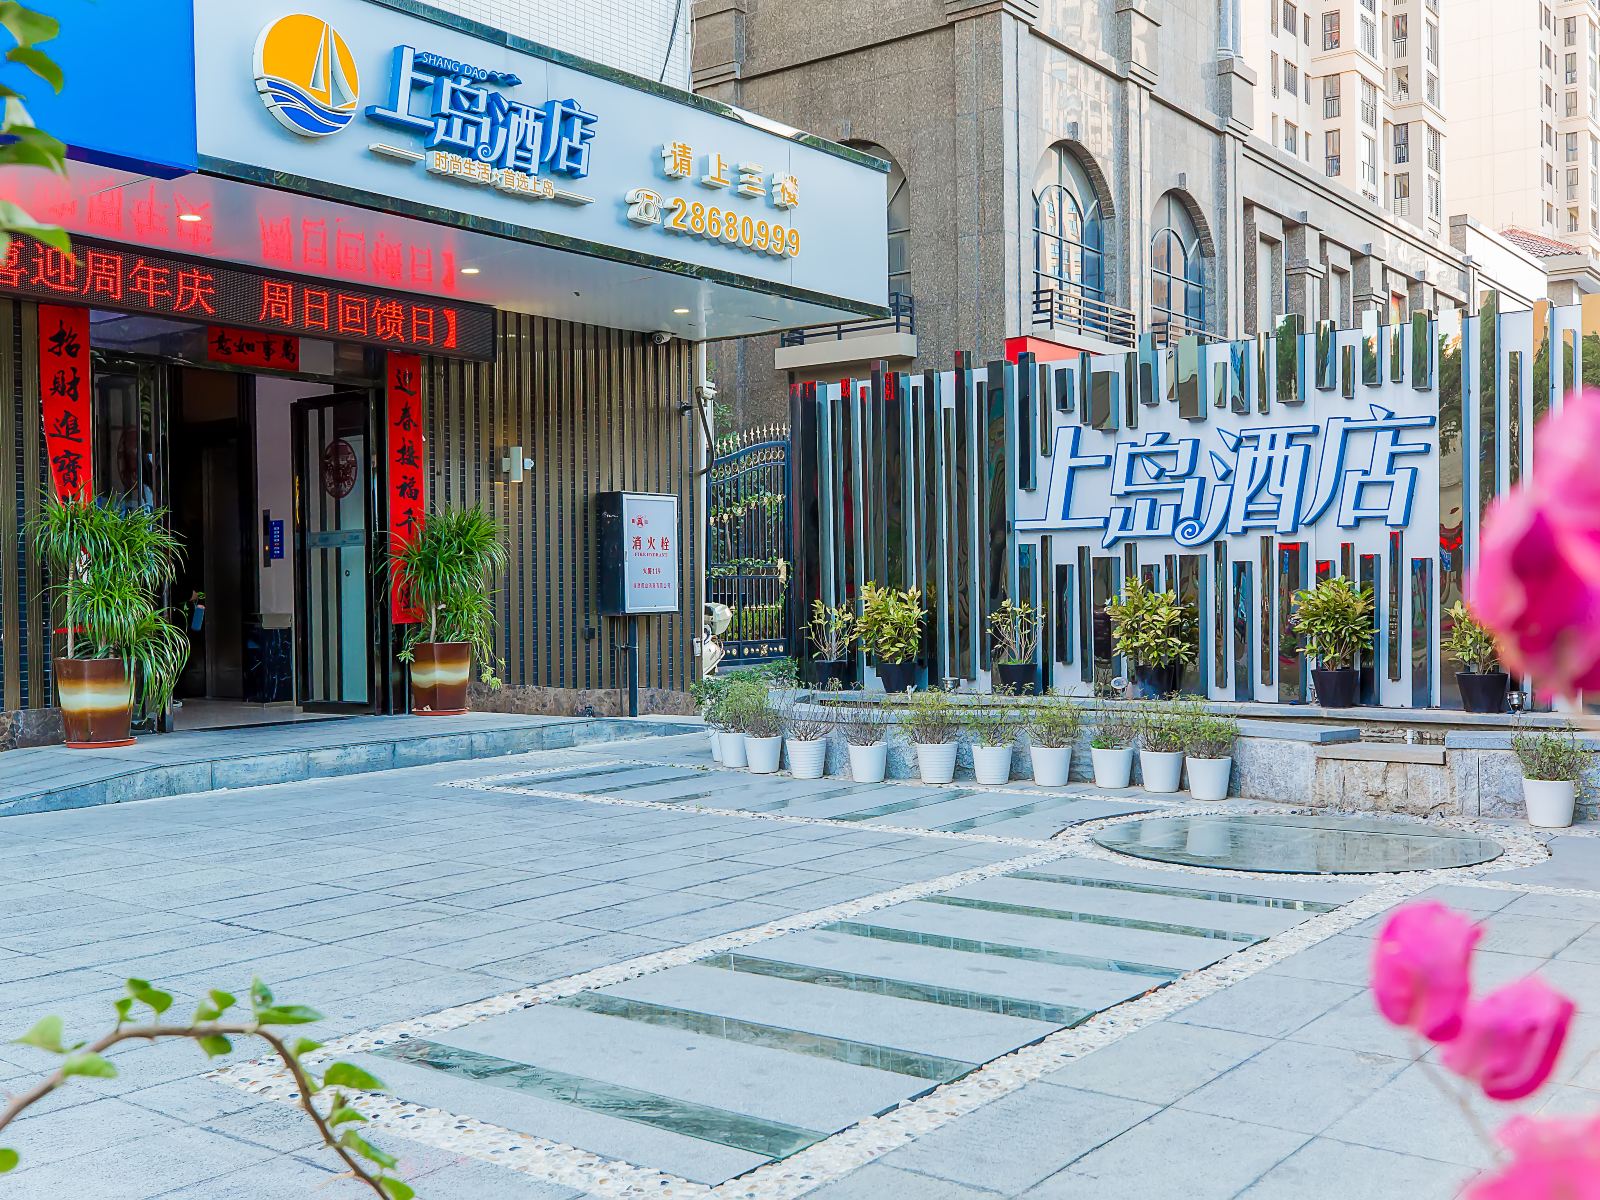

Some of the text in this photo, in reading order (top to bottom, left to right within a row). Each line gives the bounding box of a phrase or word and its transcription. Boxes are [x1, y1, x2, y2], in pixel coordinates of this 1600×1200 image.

[423, 52, 487, 80] SHANG DAO
[366, 45, 598, 178] 上岛酒店
[664, 197, 800, 258] 28680999
[1014, 403, 1437, 549] 上岛酒店
[632, 536, 670, 551] 消火栓
